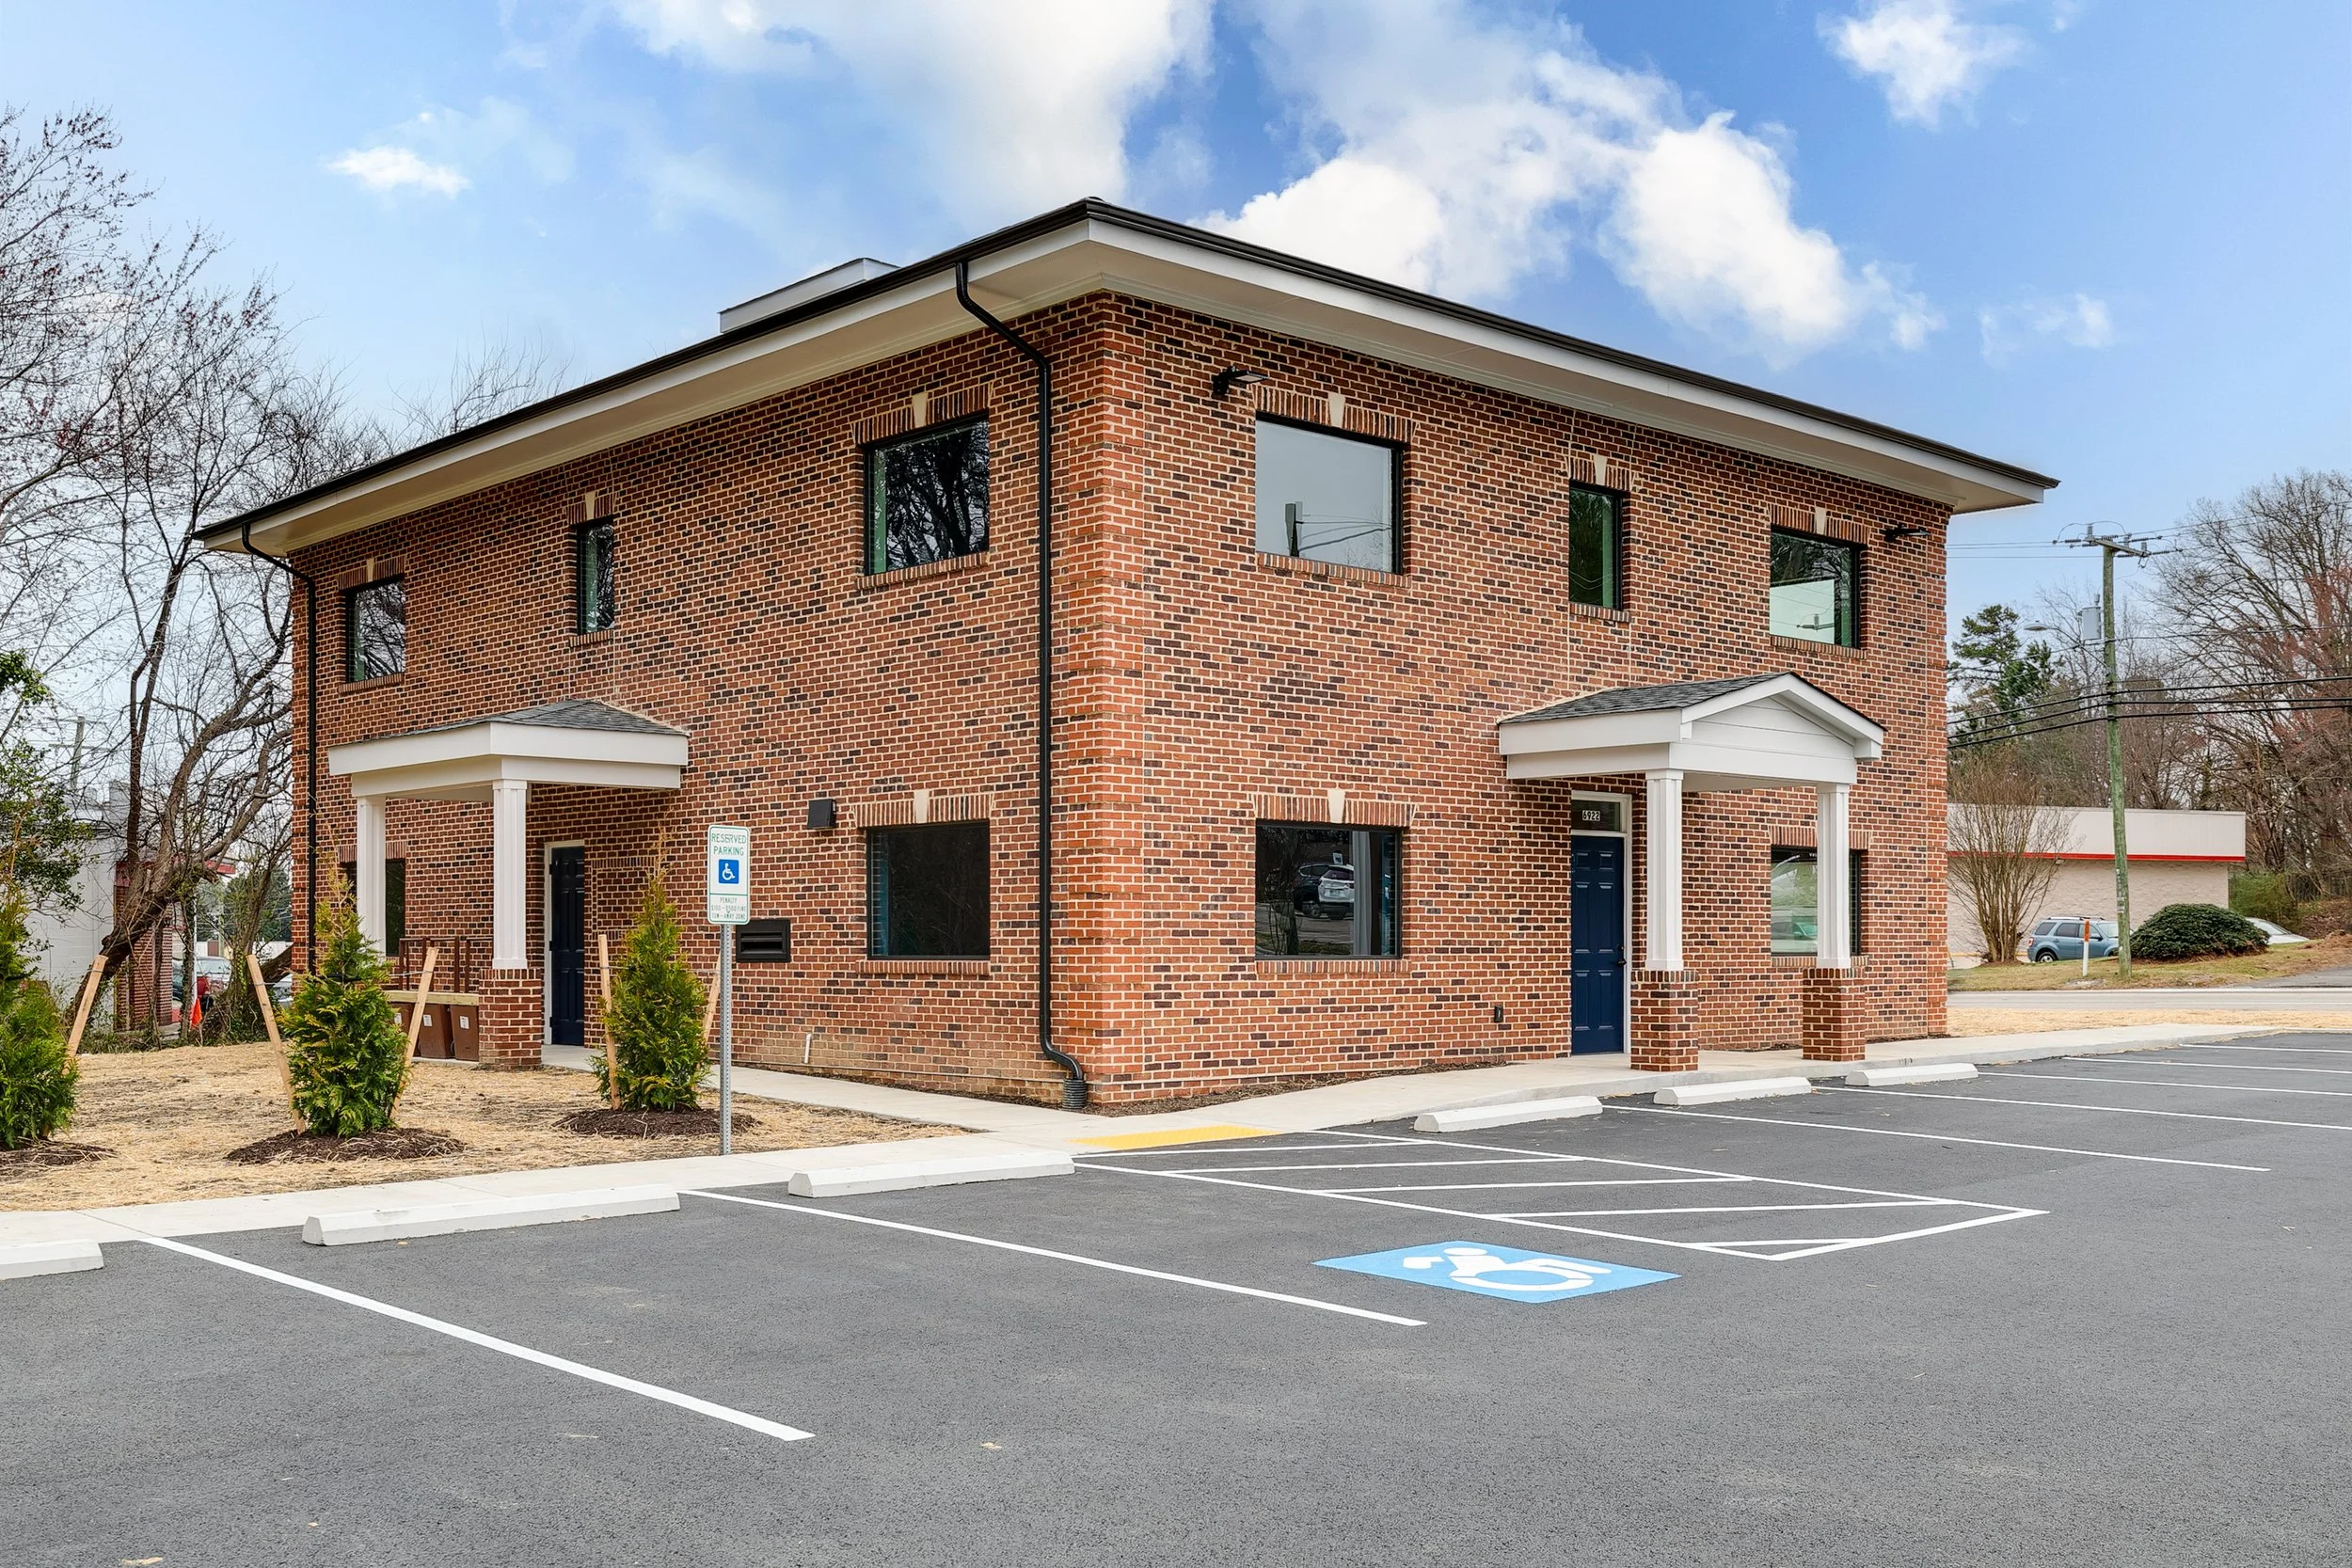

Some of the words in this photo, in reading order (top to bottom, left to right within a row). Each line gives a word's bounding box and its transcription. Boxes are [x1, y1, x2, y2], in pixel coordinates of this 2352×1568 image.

[1583, 811, 1600, 820] 6922
[711, 833, 746, 843] RESERVED
[714, 846, 744, 856] PARKING
